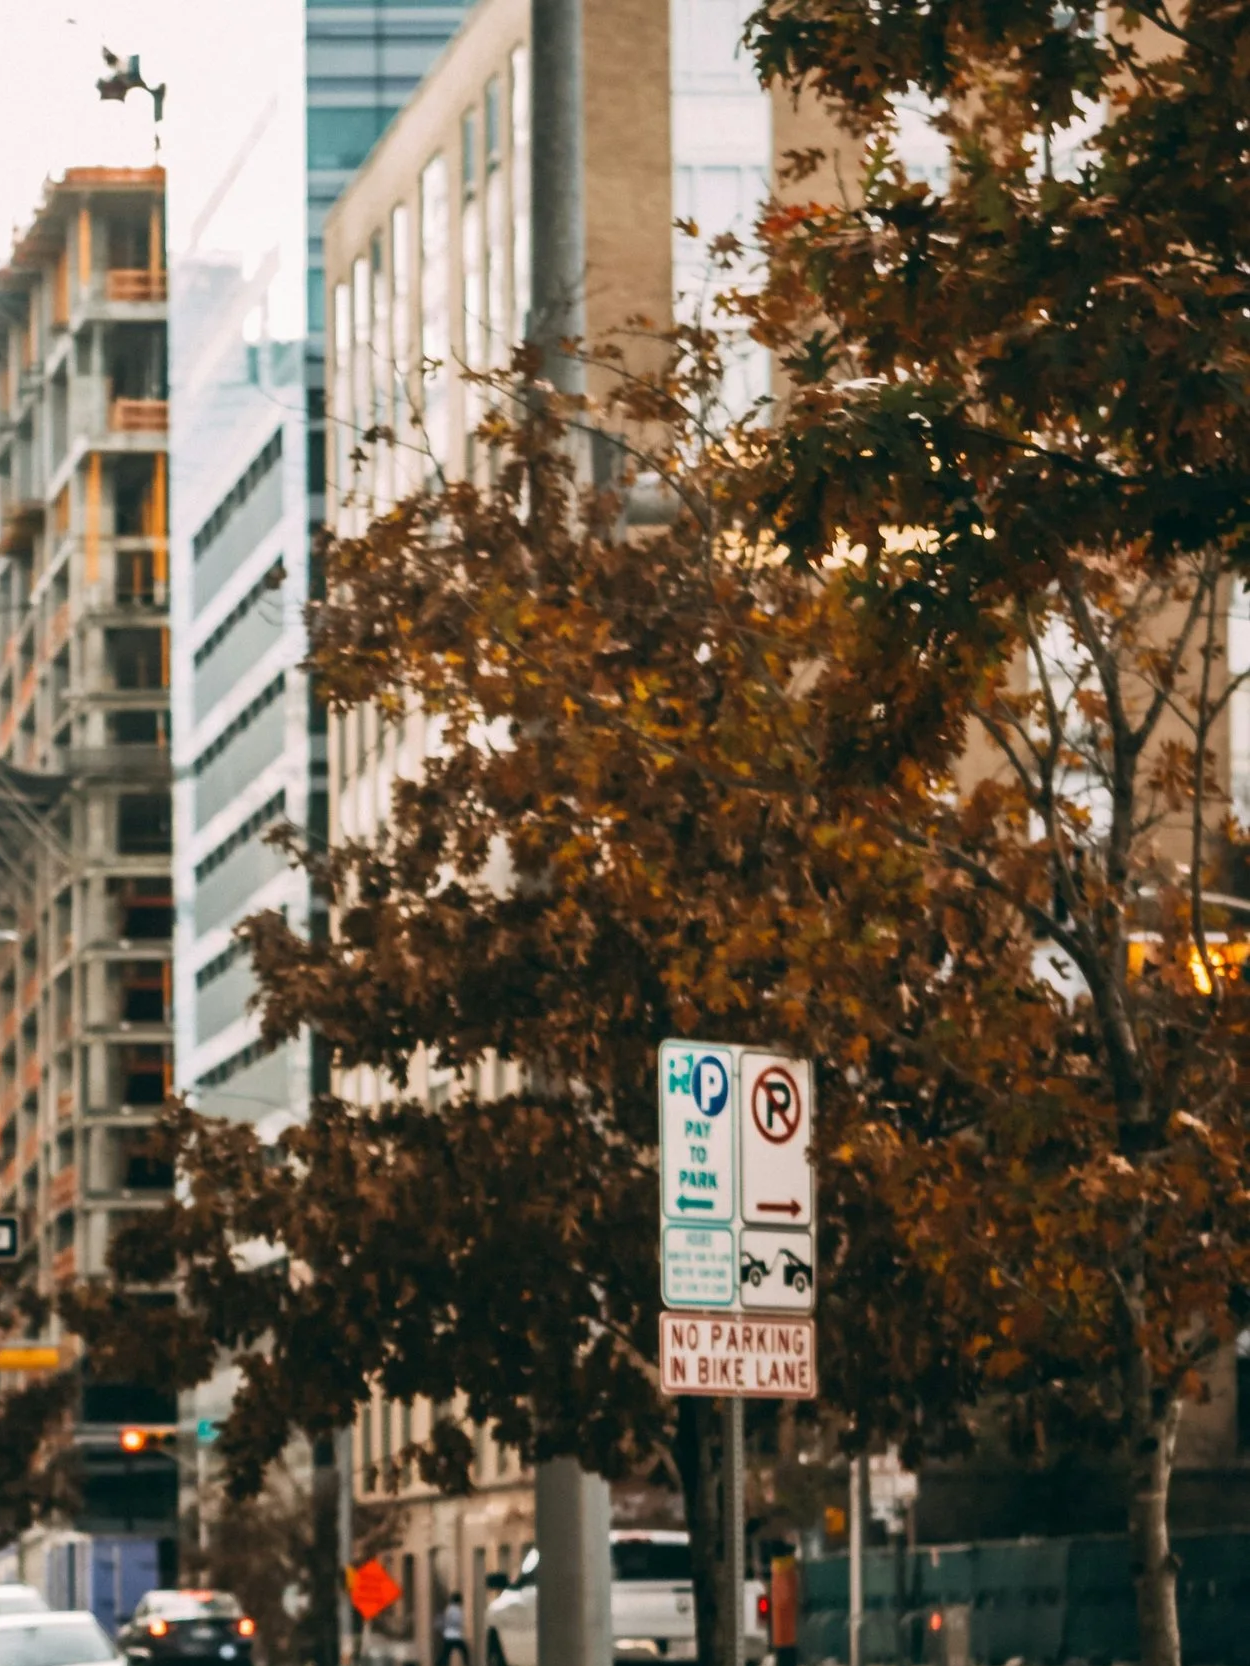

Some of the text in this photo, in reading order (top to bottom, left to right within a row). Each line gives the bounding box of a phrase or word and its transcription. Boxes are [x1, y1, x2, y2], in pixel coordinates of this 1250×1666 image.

[700, 1063, 724, 1112] P
[684, 1120, 711, 1139] PAY
[689, 1145, 708, 1164] TO
[678, 1169, 719, 1190] PARK
[670, 1323, 805, 1356] NO PARKING
[670, 1355, 809, 1389] IN BIKE LANE
